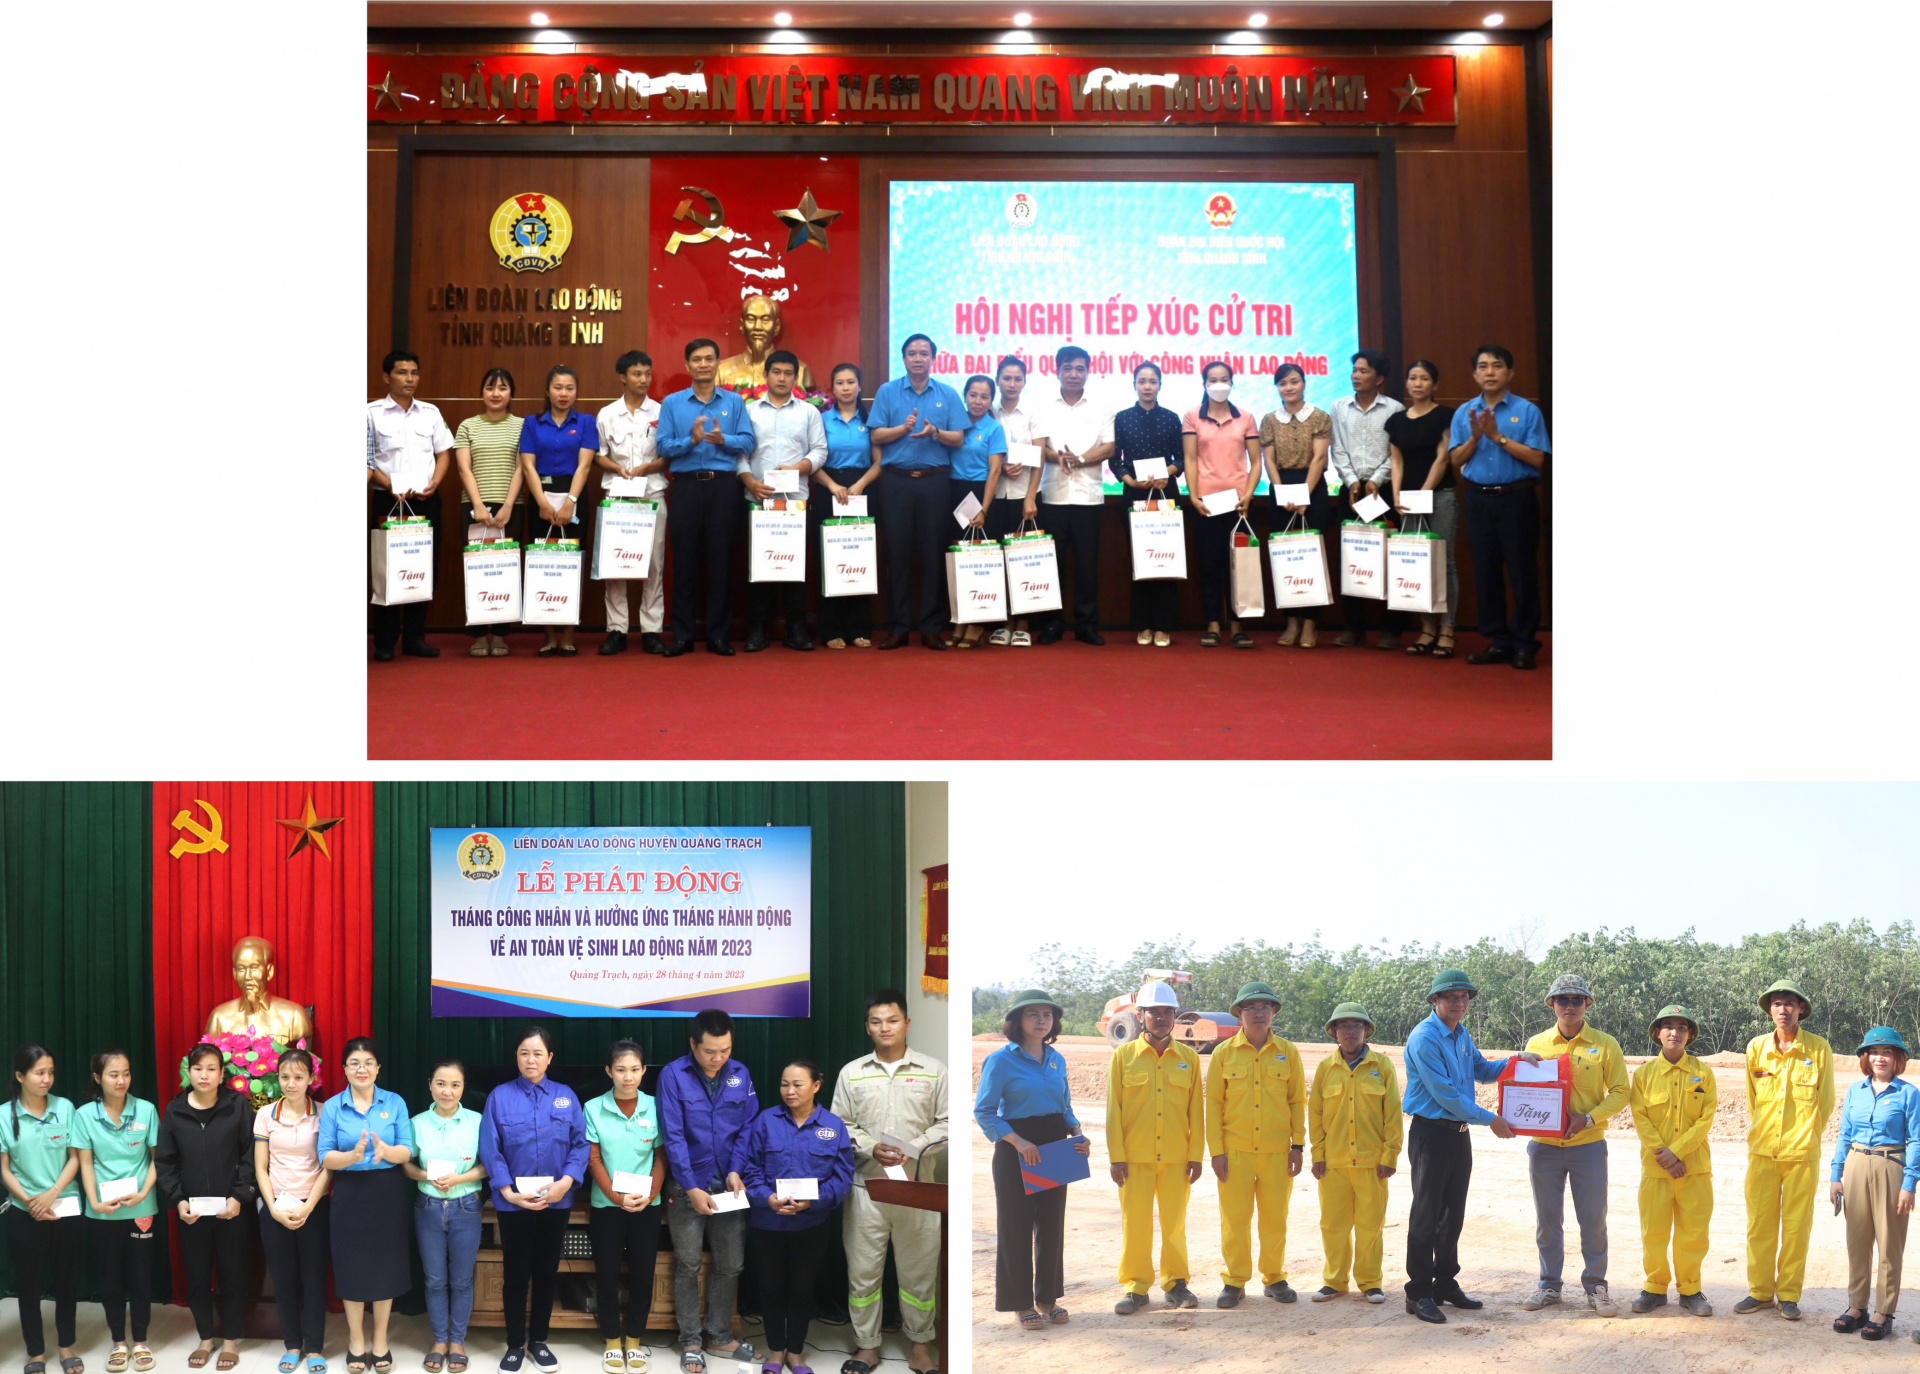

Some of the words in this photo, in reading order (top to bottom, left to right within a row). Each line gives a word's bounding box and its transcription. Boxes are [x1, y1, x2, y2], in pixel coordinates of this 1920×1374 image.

[440, 59, 539, 110] ĐẢNG
[553, 64, 650, 116] CỘNG
[662, 59, 737, 110] SẢN
[750, 64, 825, 117] VIỆT
[837, 74, 920, 110] NAM
[934, 73, 1056, 114] QUANG
[1068, 72, 1150, 111] VINH
[1164, 65, 1272, 111] MUÔN
[1284, 66, 1367, 111] NĂM
[427, 283, 469, 311] LIÊN
[475, 284, 528, 312] ĐOÀN
[534, 287, 571, 311] LAO
[574, 284, 622, 315] ĐỘNG
[439, 314, 485, 345] TỈNH
[491, 314, 553, 347] QUẢNG
[559, 315, 604, 346] BÌNH
[955, 296, 1000, 342] HỘI
[1008, 303, 1073, 342] NGHỊ
[1080, 293, 1138, 335] TIẾP
[1146, 297, 1200, 336] XÚC
[1208, 293, 1246, 336] CỬ
[1251, 303, 1293, 336] TRI
[1249, 355, 1280, 375] LAO
[513, 836, 538, 849] LIÊN
[541, 835, 574, 849] ĐOÀN
[577, 838, 600, 849] LAO
[603, 835, 636, 852] ĐỘNG
[639, 835, 678, 852] HUYỆN
[680, 833, 722, 849] QUẢNG
[725, 837, 762, 852] TRẠCH
[516, 860, 555, 893] LỄ
[563, 865, 645, 893] PHÁT
[653, 865, 742, 898] ĐỘNG
[451, 906, 493, 927] THÁNG
[496, 906, 532, 927] CÔNG
[535, 906, 571, 927] NHÂN
[575, 906, 592, 927] VÀ
[595, 903, 639, 927] HƯỞNG
[642, 906, 669, 927] ỨNG
[673, 906, 715, 927] THÁNG
[718, 906, 753, 927] HÀNH
[756, 906, 792, 930] ĐỘNG
[490, 934, 506, 956] VỀ
[509, 939, 528, 956] AN
[531, 936, 565, 957] TOÀN
[568, 936, 584, 960] VỆ
[587, 939, 619, 957] SINH
[622, 939, 646, 956] LAO
[649, 936, 685, 960] ĐỘNG
[688, 936, 718, 956] NĂM
[721, 939, 753, 957] 2023
[569, 969, 600, 981] Quảng
[601, 969, 630, 982] Trạch,
[632, 969, 654, 981] ngày
[655, 970, 667, 979] 28
[668, 969, 695, 981] tháng
[695, 970, 702, 979] 4
[703, 969, 723, 979] năm
[724, 970, 745, 979] 2023
[1513, 1103, 1551, 1125] Tặng
